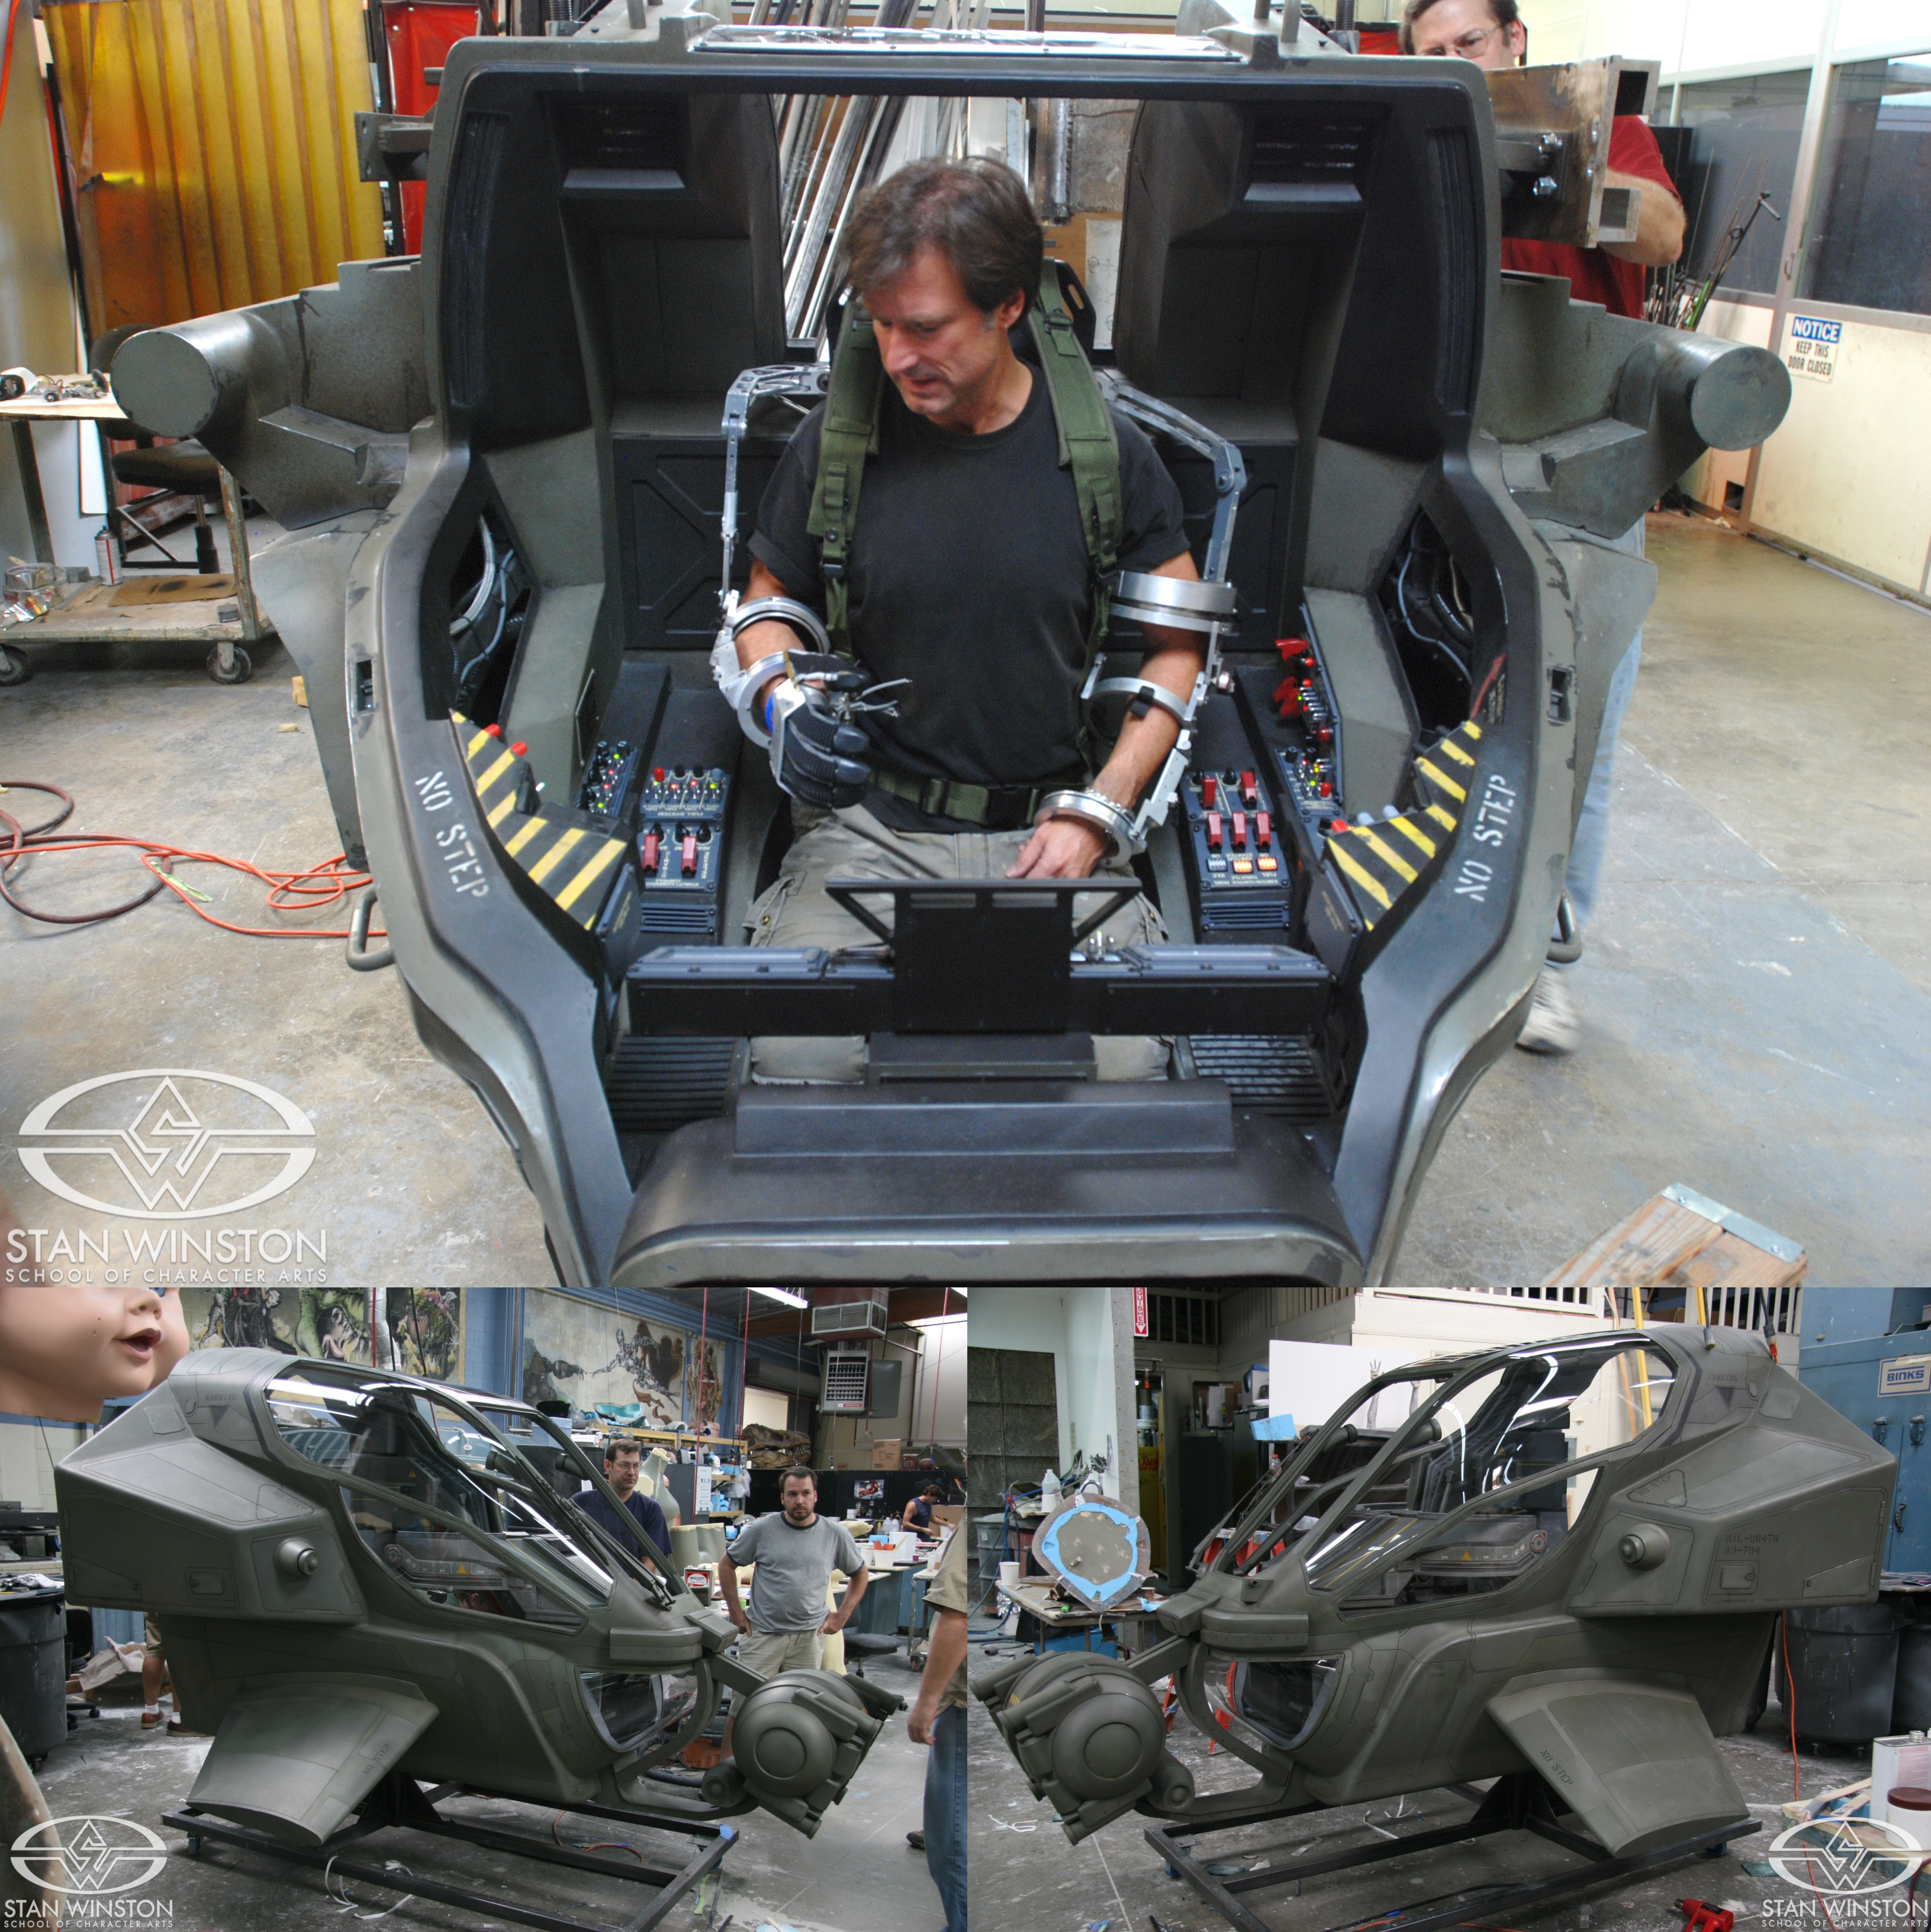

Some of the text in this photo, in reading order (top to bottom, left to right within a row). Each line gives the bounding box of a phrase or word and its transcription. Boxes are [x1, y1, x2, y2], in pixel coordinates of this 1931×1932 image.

[1793, 318, 1840, 342] NOTICE
[1795, 341, 1829, 358] KEEP THIS
[1788, 355, 1832, 375] DOOR CLOSED
[1473, 774, 1516, 846] STEP
[415, 771, 490, 897] NO STEP
[1454, 860, 1494, 902] NO
[1636, 1474, 1671, 1496] NO STEP
[272, 1490, 308, 1510] NO STEP
[1514, 1544, 1526, 1556] AT-99
[361, 1743, 391, 1775] NO STEP
[1540, 1749, 1574, 1785] NO STEP
